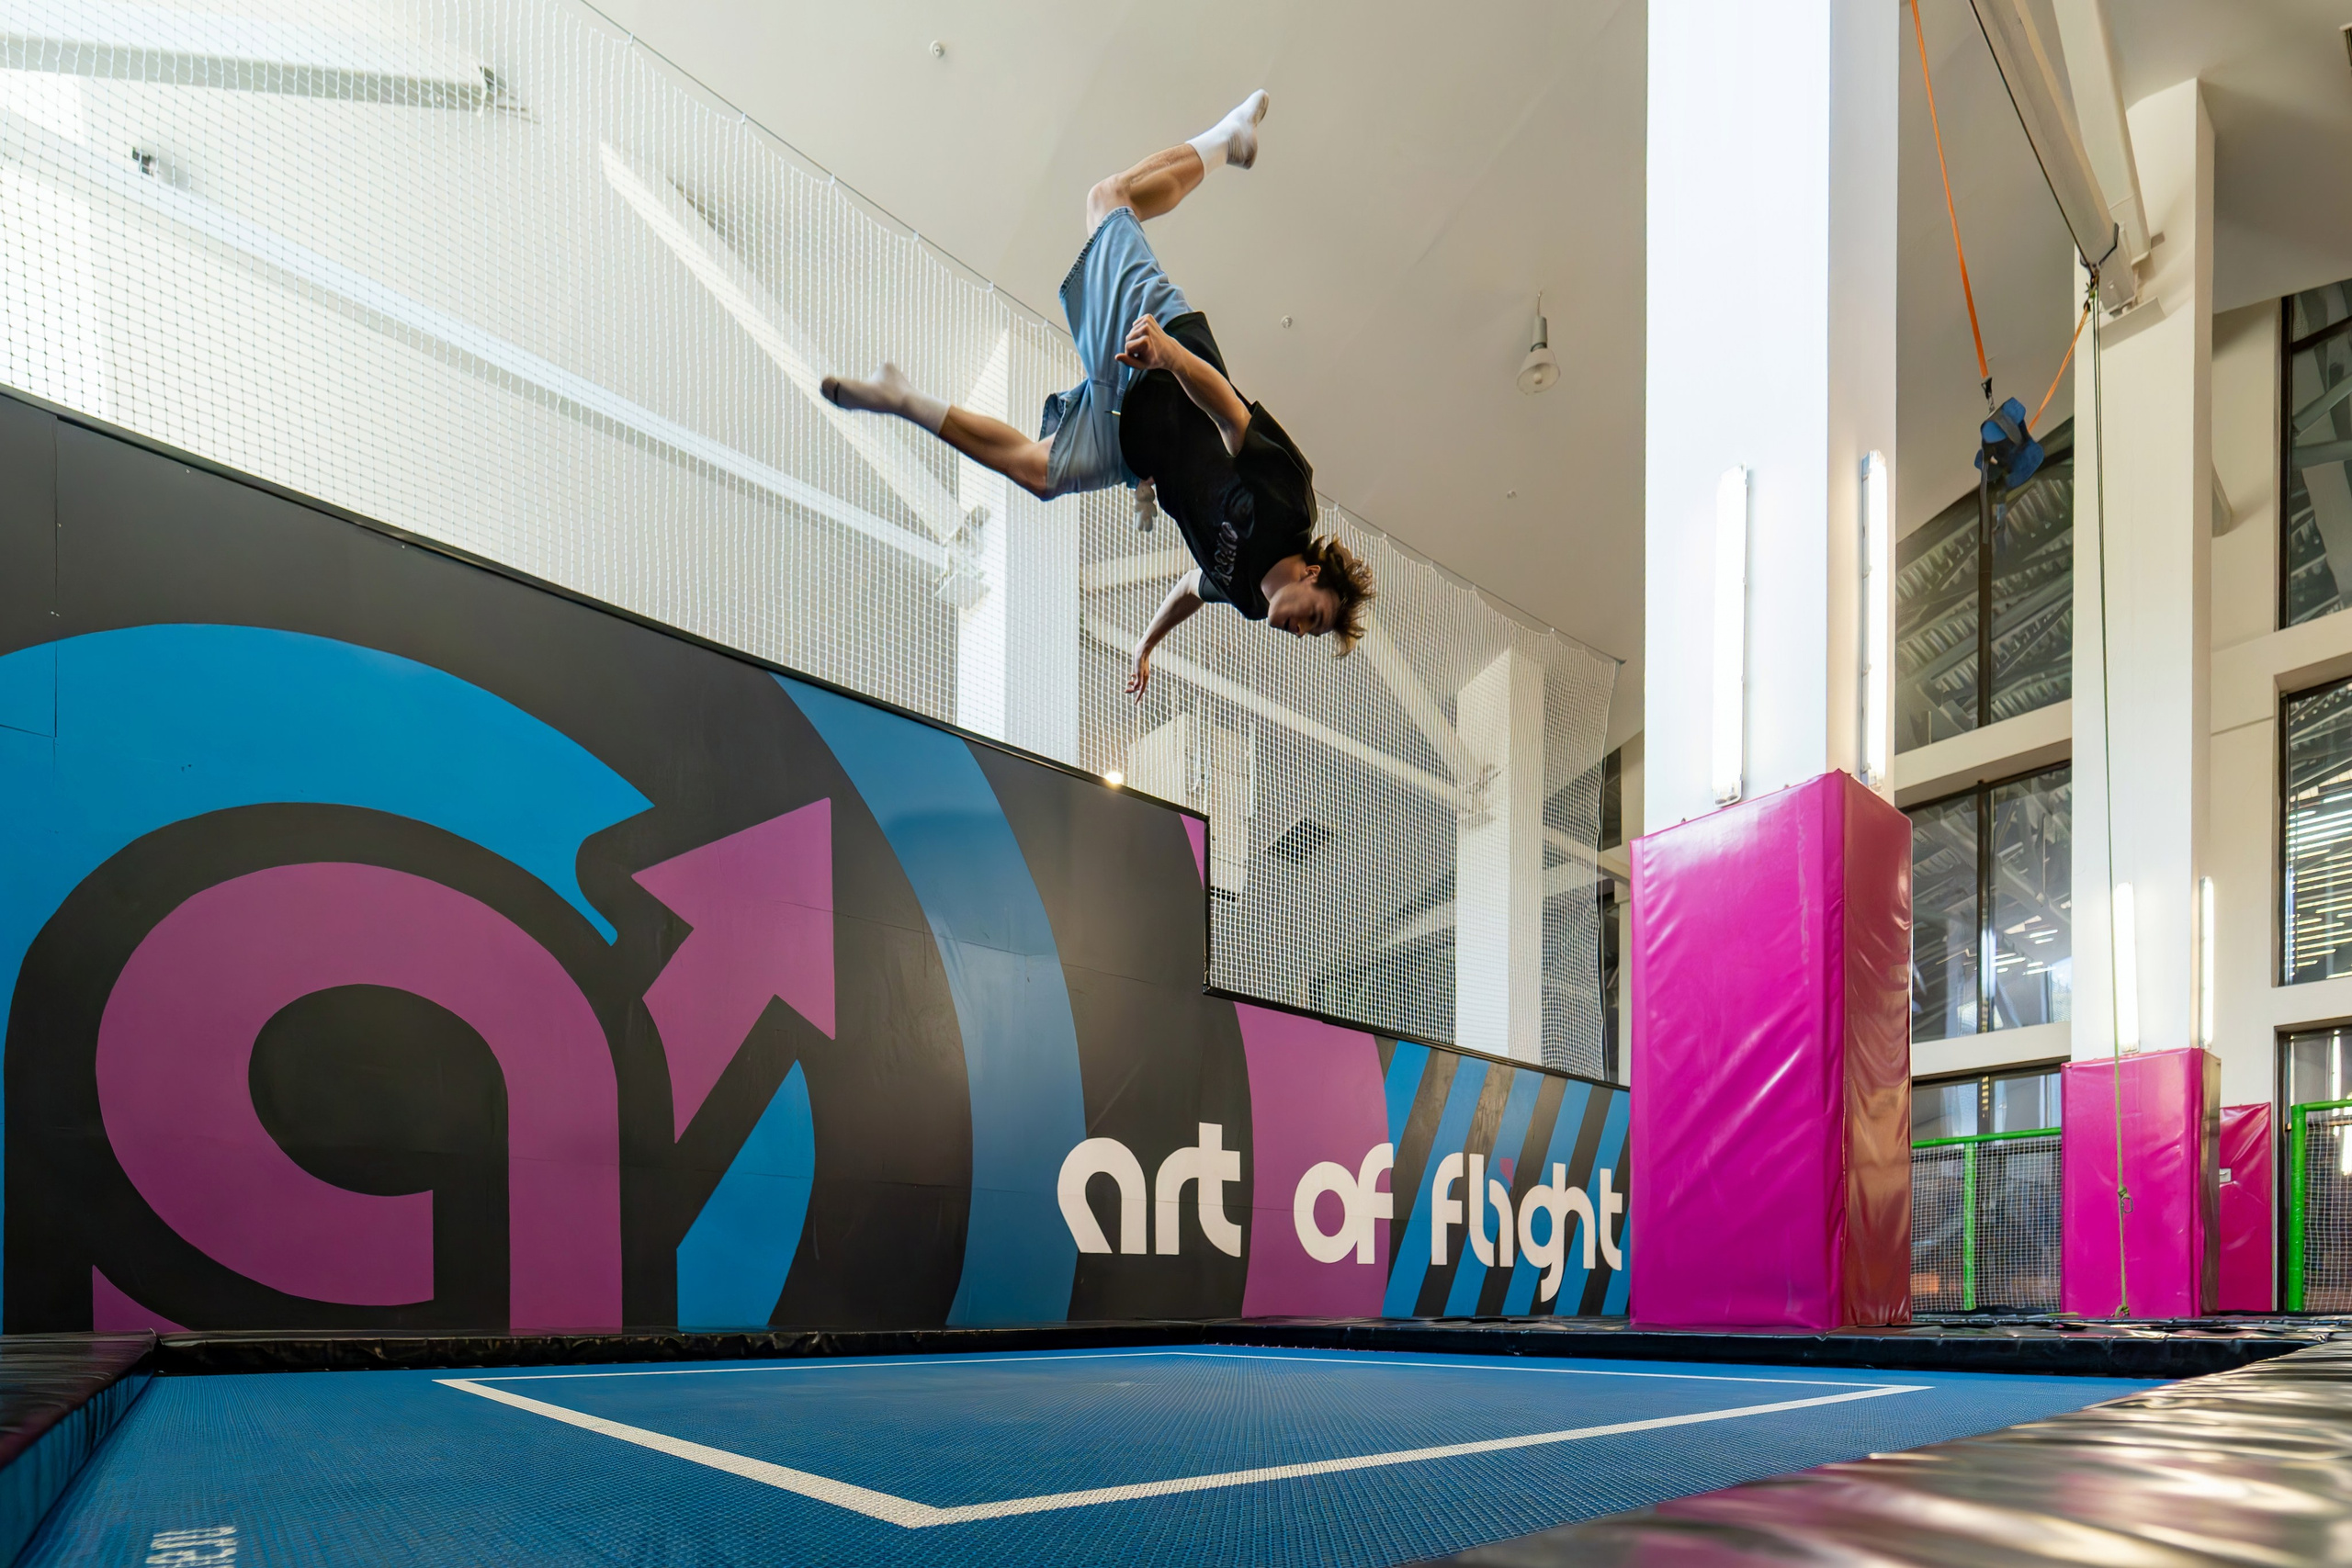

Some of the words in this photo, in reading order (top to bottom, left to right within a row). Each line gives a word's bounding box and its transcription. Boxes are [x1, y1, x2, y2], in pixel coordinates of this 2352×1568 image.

[1057, 1122, 1241, 1258] art
[1293, 1143, 1394, 1264] of
[1430, 1152, 1623, 1303] flight
